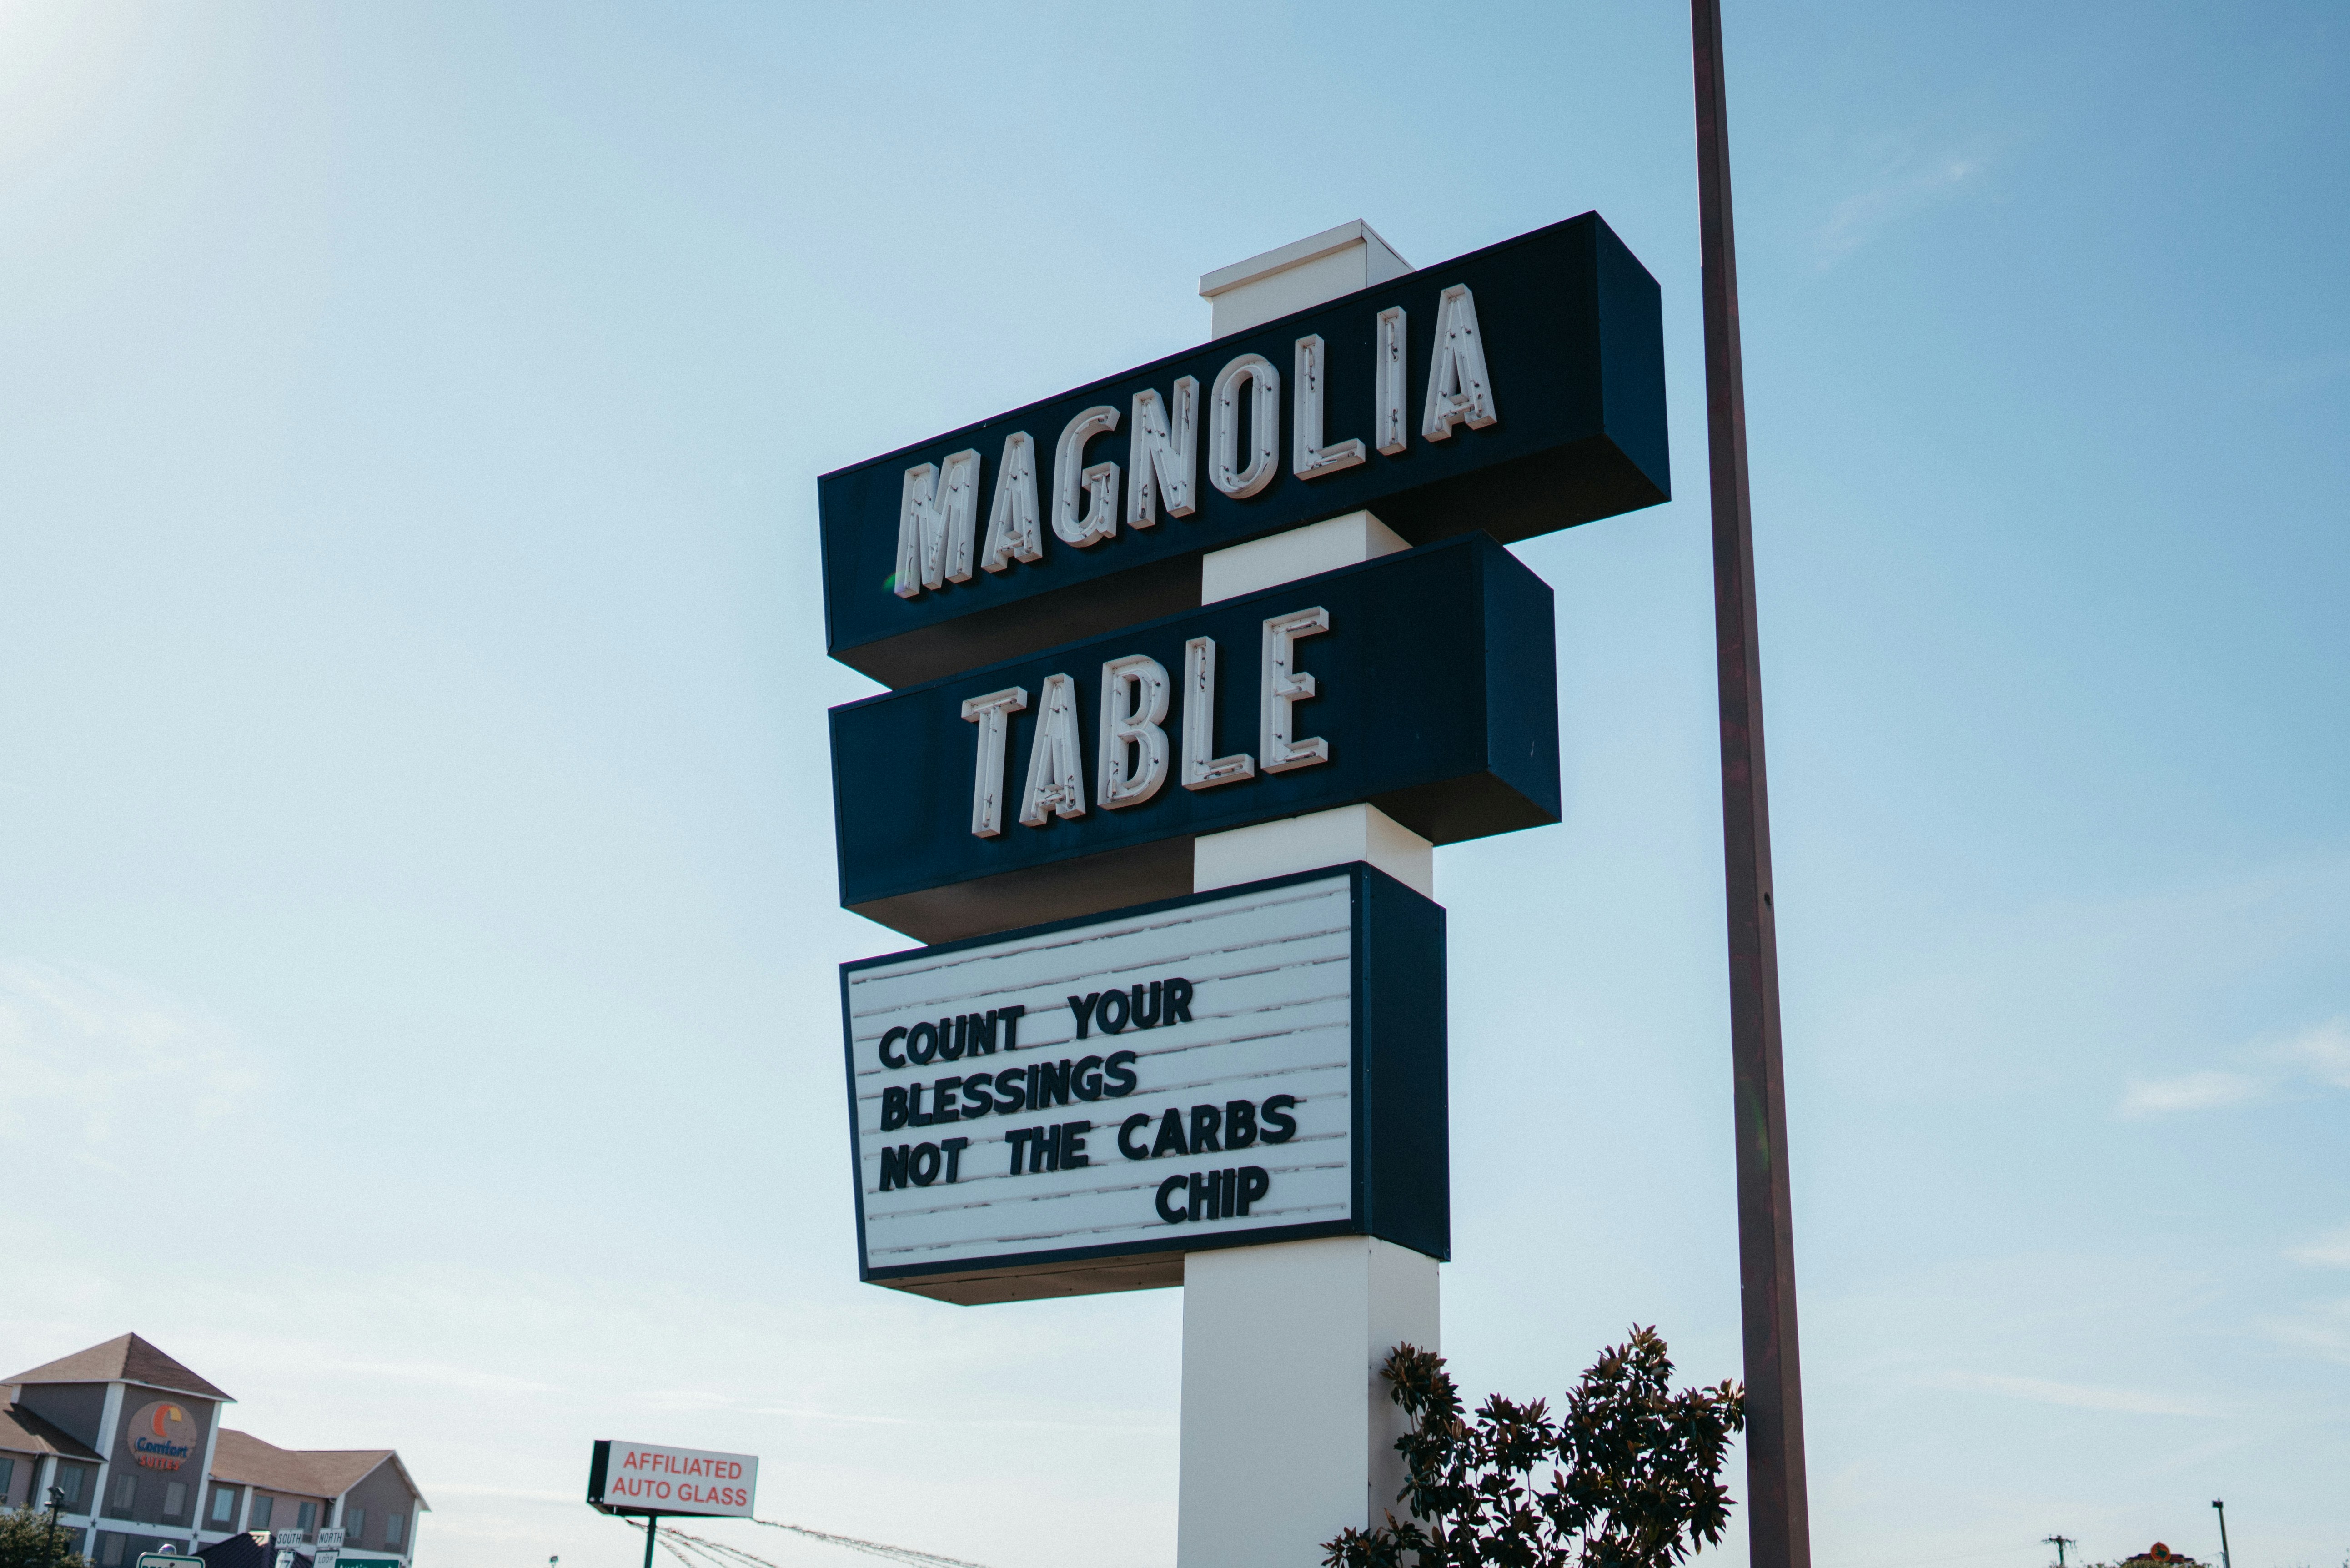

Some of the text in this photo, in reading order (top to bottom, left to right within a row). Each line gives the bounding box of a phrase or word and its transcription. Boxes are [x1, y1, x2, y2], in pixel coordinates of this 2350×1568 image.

[893, 283, 1498, 599] MAGNOLIA
[960, 605, 1329, 838] TABLE
[879, 977, 1193, 1069] COUNT YOUR
[880, 1050, 1137, 1131] BLESSINGS
[879, 1094, 1296, 1191] NOT THE CARBS
[1155, 1165, 1269, 1224] CHIP
[136, 1437, 188, 1458] Comfort
[139, 1455, 180, 1470] SUITES
[623, 1452, 742, 1479] AFFILIATED
[612, 1477, 747, 1507] AUTO GLASS
[277, 1533, 301, 1544] SOUTH
[319, 1533, 342, 1543] NORTH
